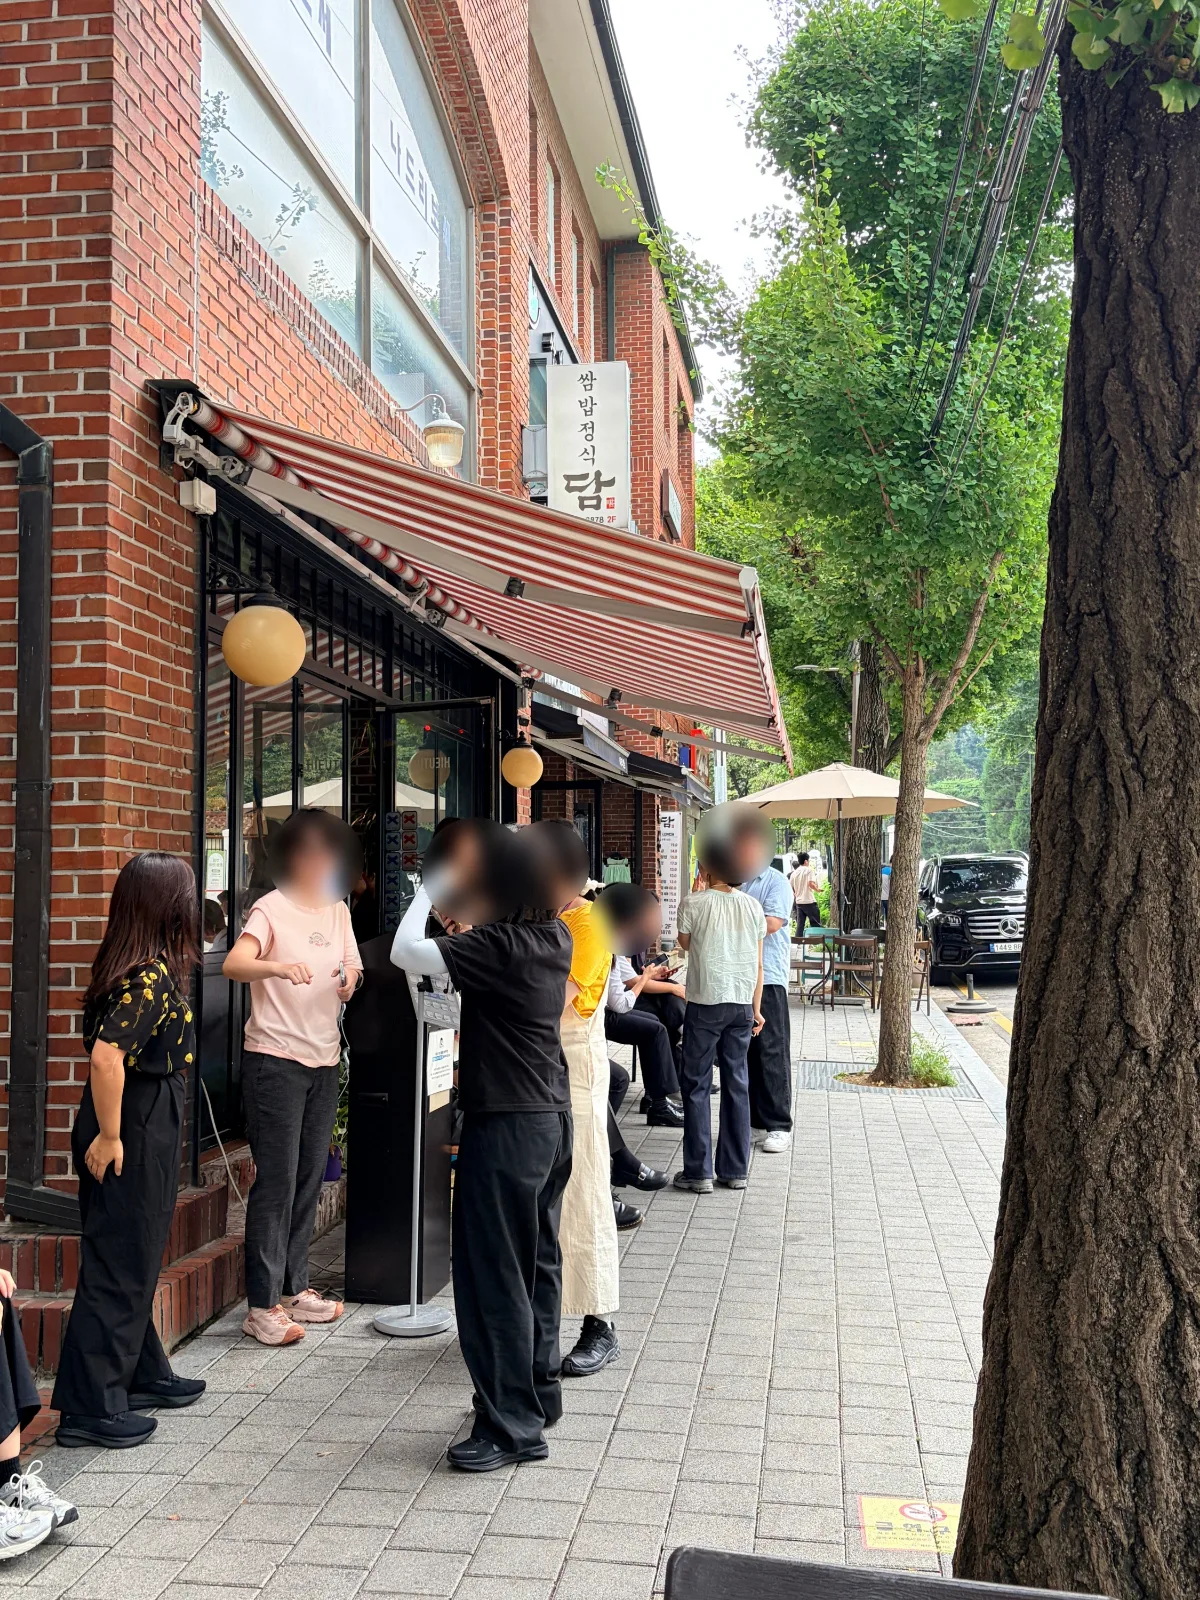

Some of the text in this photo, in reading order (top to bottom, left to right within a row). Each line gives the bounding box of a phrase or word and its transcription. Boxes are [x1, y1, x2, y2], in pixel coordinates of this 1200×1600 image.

[576, 370, 598, 467] 쌈밥정식
[563, 469, 616, 511] 담
[607, 515, 617, 523] 2F
[661, 815, 675, 828] 담
